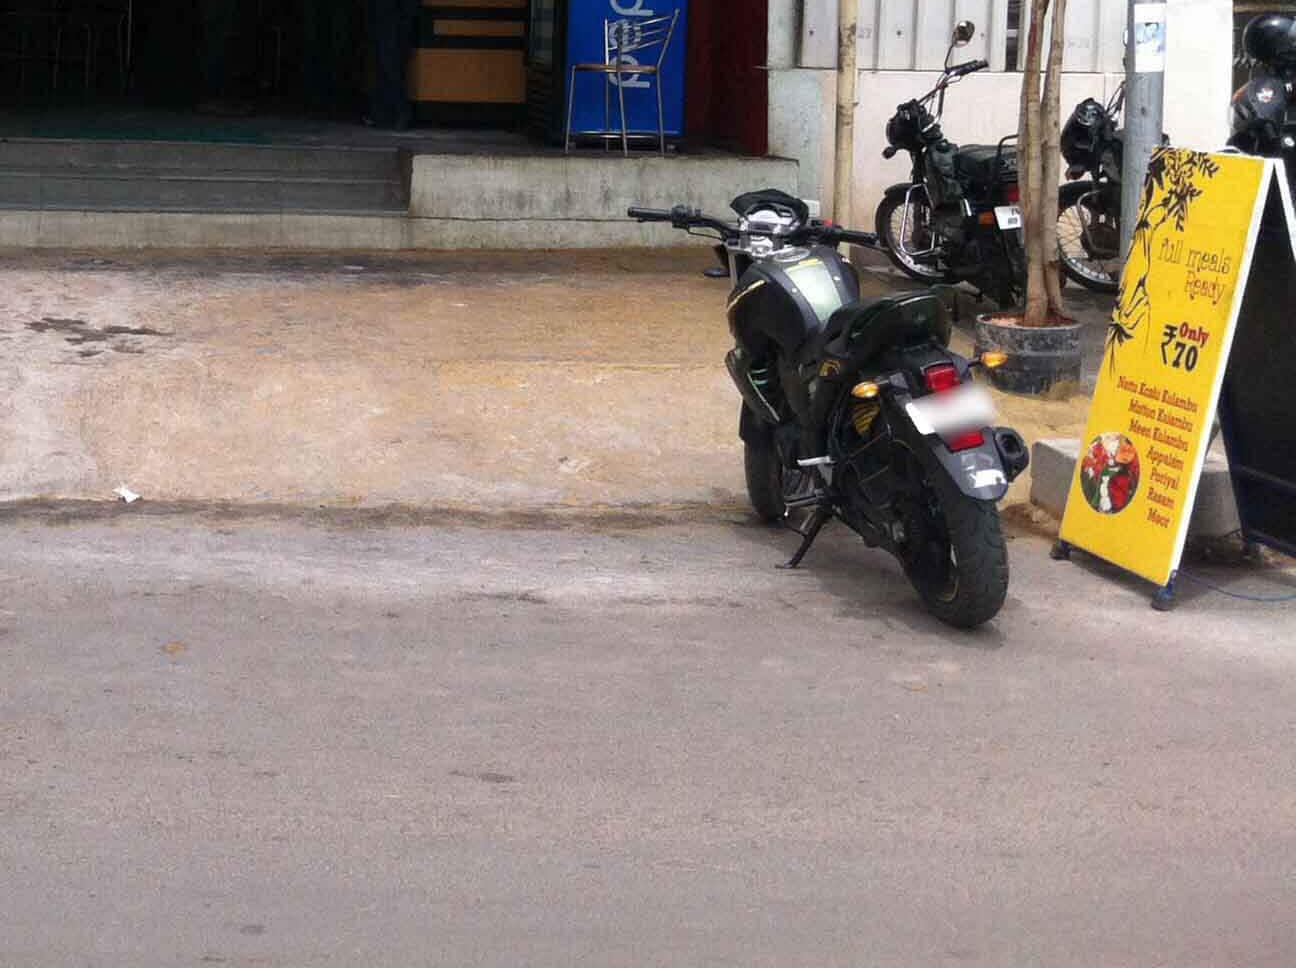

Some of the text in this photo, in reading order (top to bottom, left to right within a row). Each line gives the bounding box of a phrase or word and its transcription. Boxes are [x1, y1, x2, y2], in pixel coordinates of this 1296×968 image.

[1185, 247, 1232, 274] meals
[1184, 270, 1226, 305] Ready
[1179, 321, 1210, 349] Only
